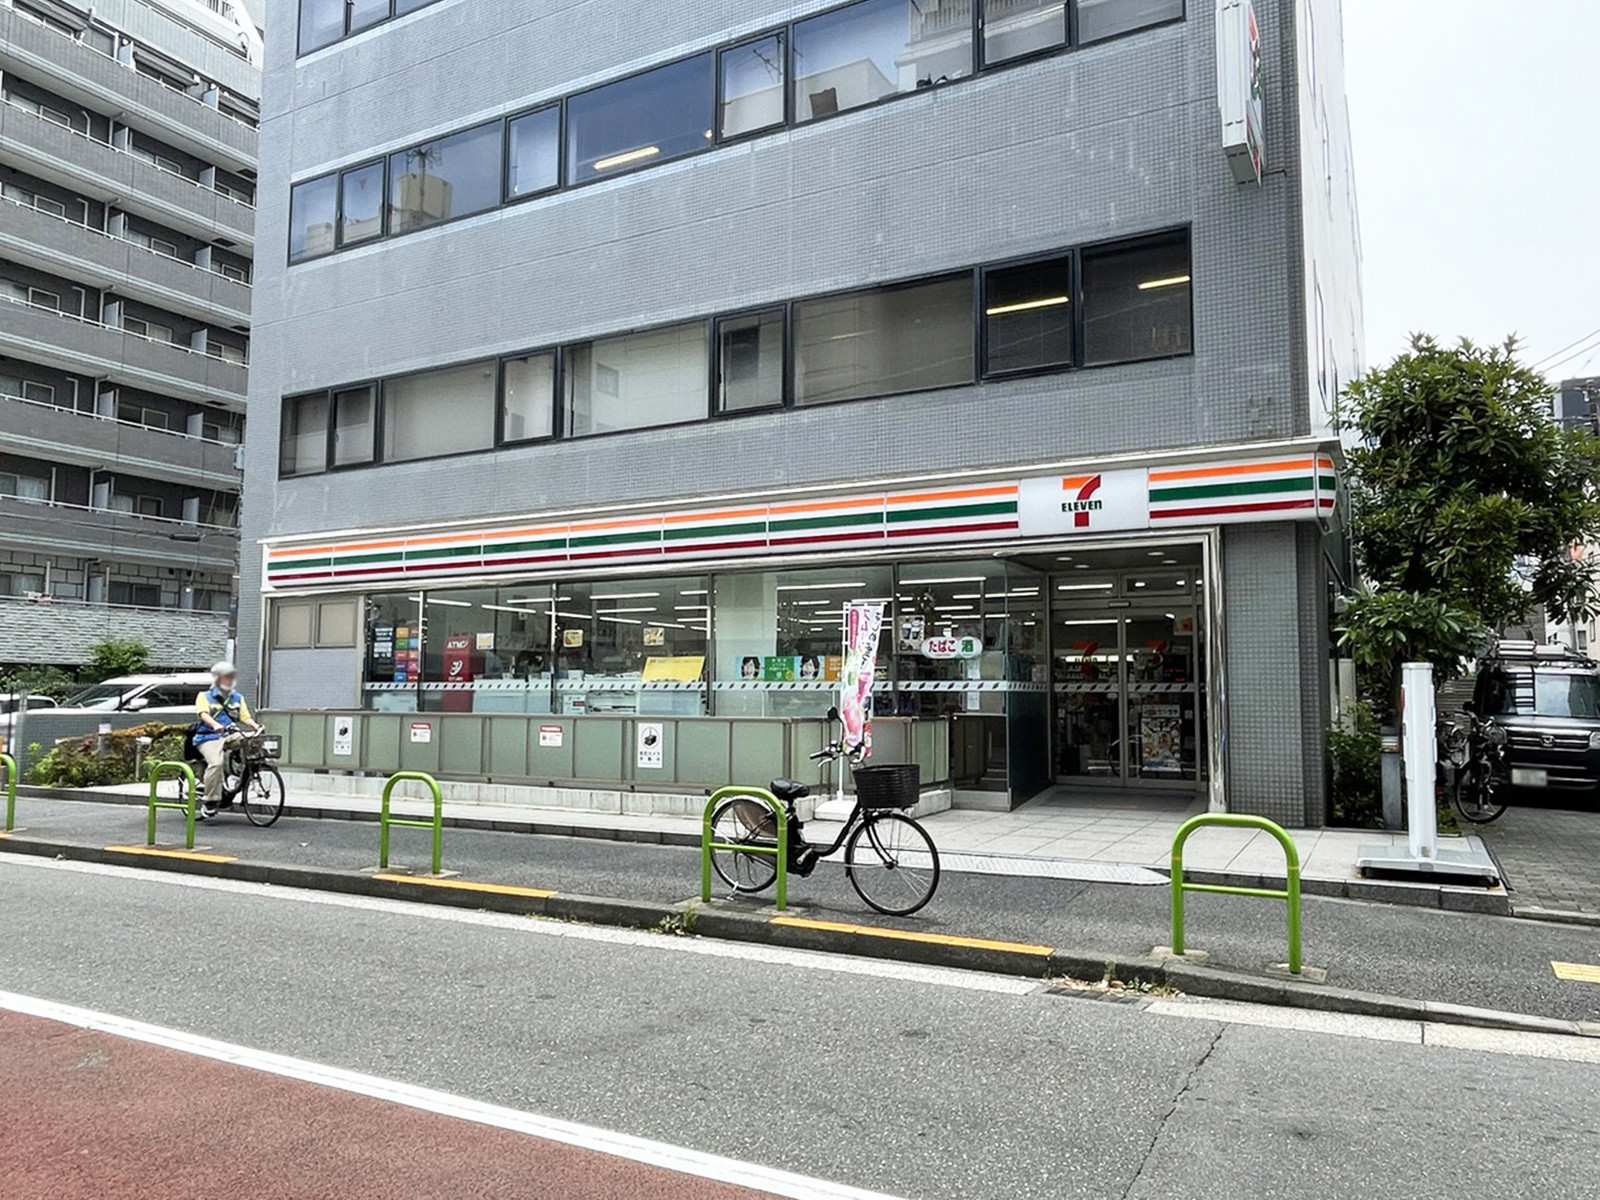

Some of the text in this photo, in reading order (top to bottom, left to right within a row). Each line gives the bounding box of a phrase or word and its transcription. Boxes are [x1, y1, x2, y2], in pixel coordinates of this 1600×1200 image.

[1062, 474, 1101, 527] 7
[447, 640, 465, 649] ATM
[928, 640, 956, 653] たばこ
[961, 639, 974, 653] 酒
